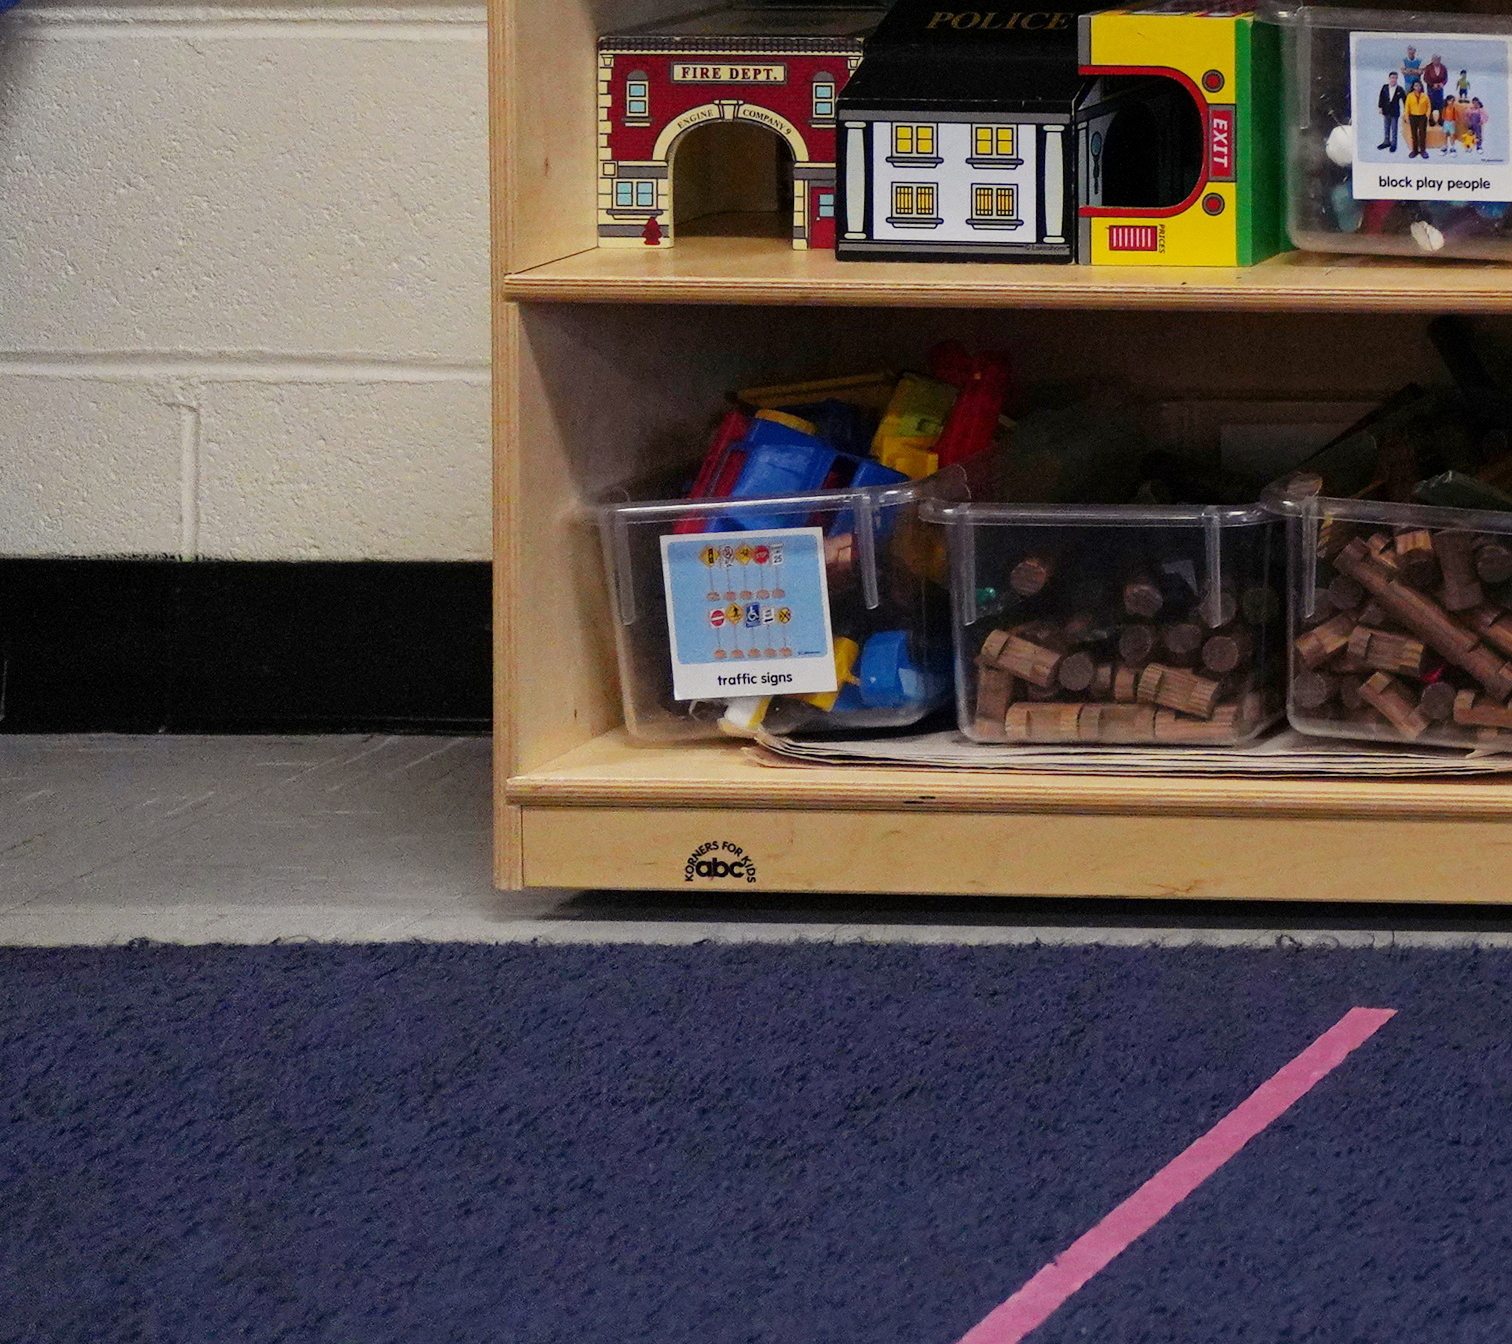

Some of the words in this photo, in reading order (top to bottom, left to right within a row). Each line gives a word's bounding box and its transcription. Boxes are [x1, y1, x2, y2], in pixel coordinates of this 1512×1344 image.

[925, 9, 1075, 32] POLICE
[680, 64, 727, 82] FIRE
[731, 64, 779, 82] DEPT.
[675, 107, 715, 132] ENGINE
[741, 106, 784, 130] COMPANY
[1211, 117, 1230, 170] EXIT
[1378, 174, 1412, 190] block
[1415, 174, 1441, 193] play
[1443, 174, 1491, 193] people
[1157, 223, 1166, 254] PRICES
[716, 669, 758, 687] traffic
[760, 669, 793, 690] signs
[685, 840, 719, 882] KORNERS
[722, 840, 743, 858] FOR
[741, 856, 757, 883] KIDS
[695, 857, 746, 879] abc
